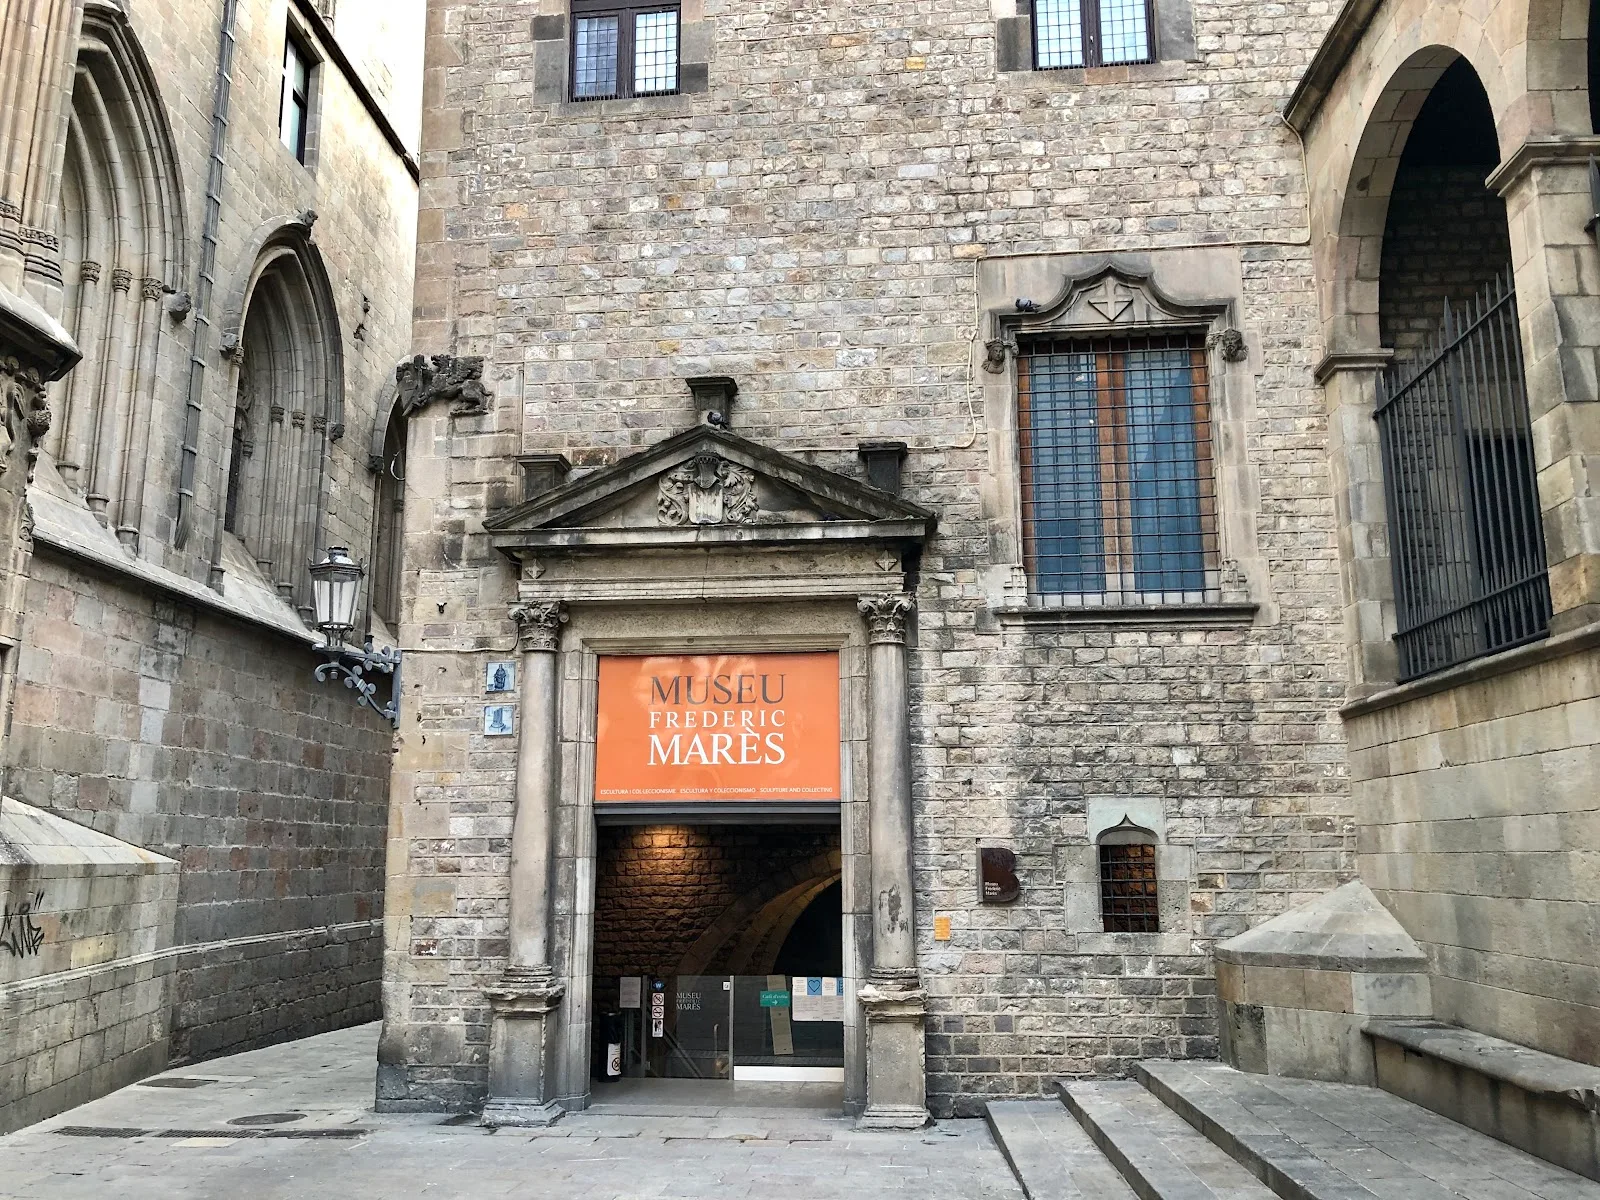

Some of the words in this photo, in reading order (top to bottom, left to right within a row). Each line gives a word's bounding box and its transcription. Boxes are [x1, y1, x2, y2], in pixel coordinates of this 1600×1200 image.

[649, 673, 787, 705] MUSEU
[648, 709, 786, 729] FREDERIC
[647, 727, 786, 766] MARÈS
